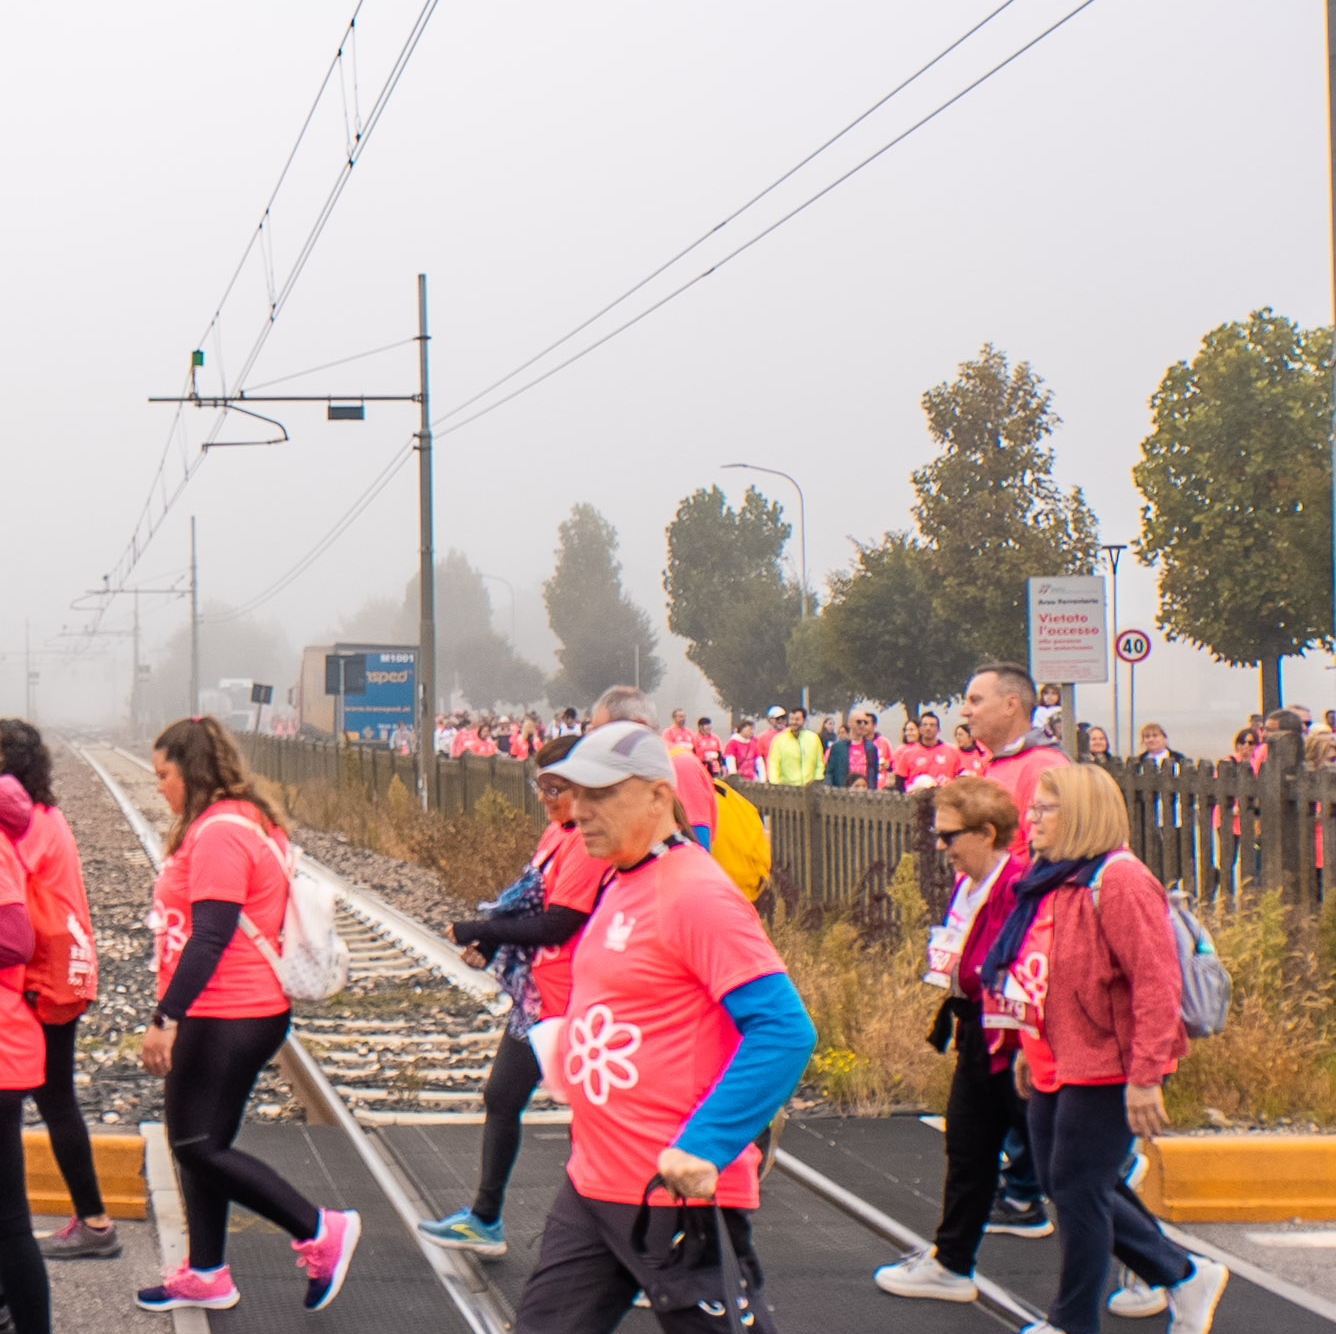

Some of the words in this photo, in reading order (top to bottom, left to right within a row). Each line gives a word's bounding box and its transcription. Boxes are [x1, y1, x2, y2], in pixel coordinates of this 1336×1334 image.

[1039, 613, 1089, 623] Vietato
[1039, 626, 1100, 636] l'accesso
[1122, 638, 1144, 654] 40
